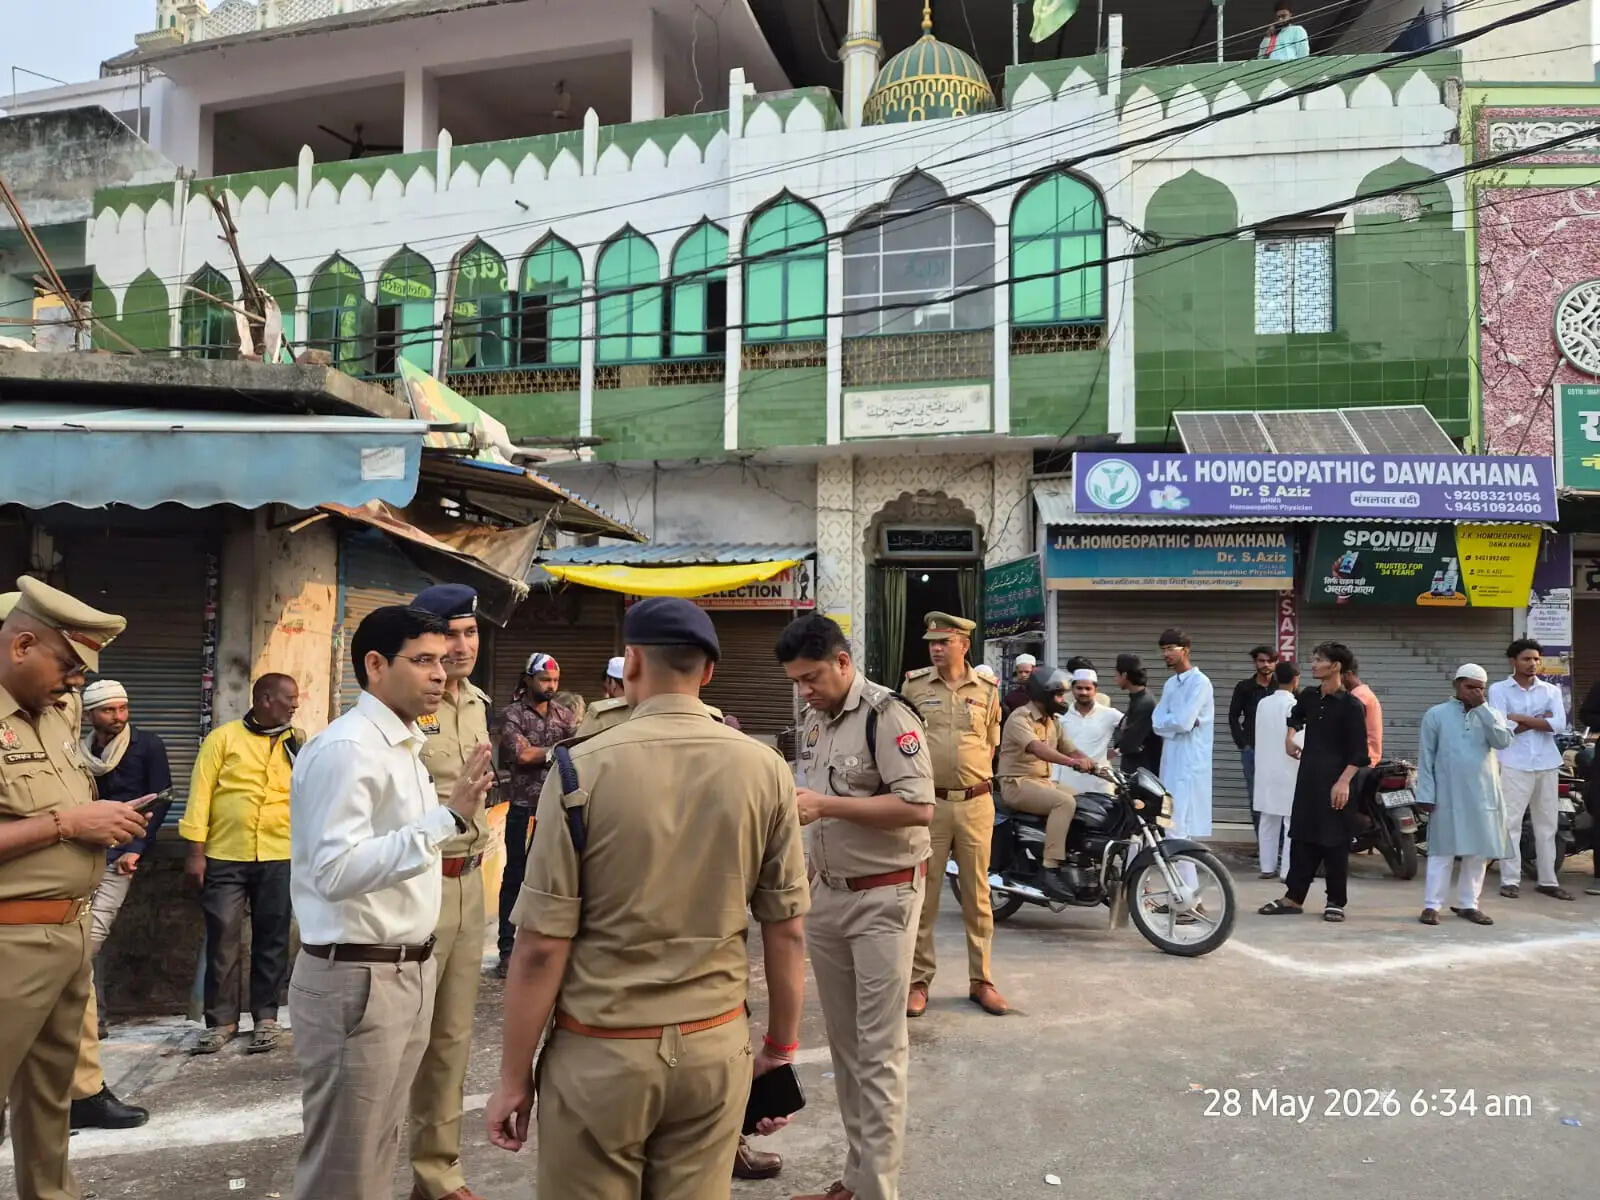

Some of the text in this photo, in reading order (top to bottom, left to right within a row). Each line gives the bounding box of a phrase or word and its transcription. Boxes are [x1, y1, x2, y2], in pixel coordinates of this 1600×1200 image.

[1147, 460, 1539, 487] J.K. HOMOEOPATHIC DAWAKHANA
[1230, 485, 1311, 497] Dr. S Aziz
[1454, 490, 1541, 502] 9208321054
[1354, 493, 1418, 504] मंगलवार बंदी
[1280, 504, 1313, 512] Physician
[1454, 502, 1542, 514] 9451092400
[1194, 533, 1286, 548] DAWAKHANA
[1343, 530, 1437, 547] SPONDIN
[1217, 551, 1236, 563] Dr.
[1375, 562, 1423, 571] TRUSTED FOR
[699, 584, 783, 599] LLECTION
